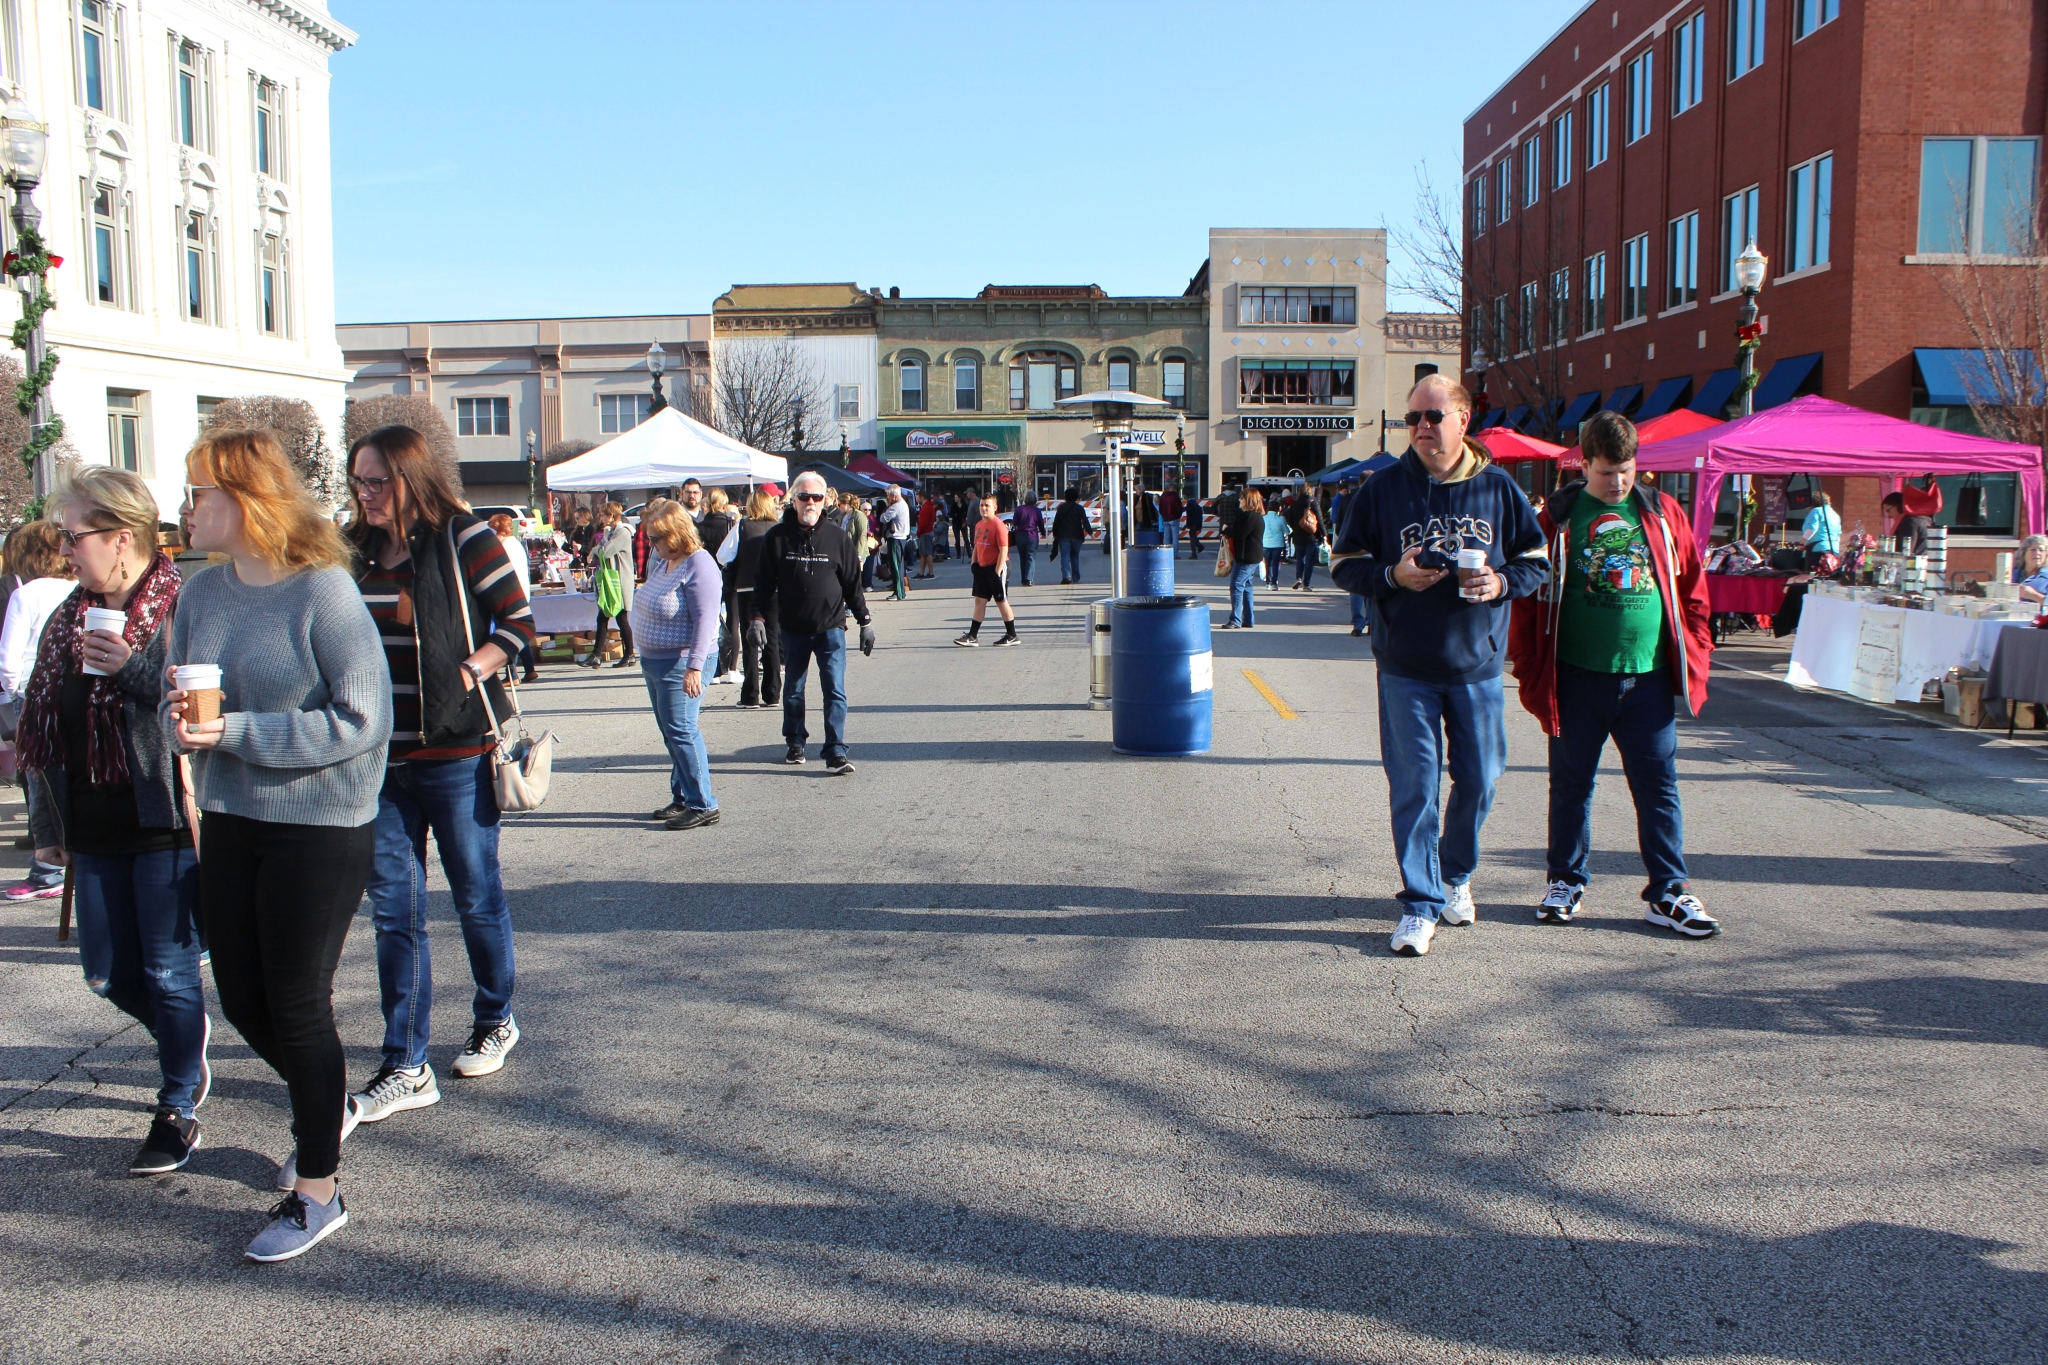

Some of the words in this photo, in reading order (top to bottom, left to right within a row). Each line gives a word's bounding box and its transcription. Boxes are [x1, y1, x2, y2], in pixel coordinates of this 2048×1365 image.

[1247, 418, 1302, 429] BIGELO'S
[1307, 418, 1349, 429] BISTRO
[909, 435, 945, 445] MOJO'S
[1133, 432, 1160, 442] WELL
[1400, 517, 1493, 553] RAMS
[1583, 593, 1602, 601] MAY
[1586, 600, 1598, 608] BE
[1600, 602, 1624, 610] WITH
[1625, 603, 1646, 611] YOU
